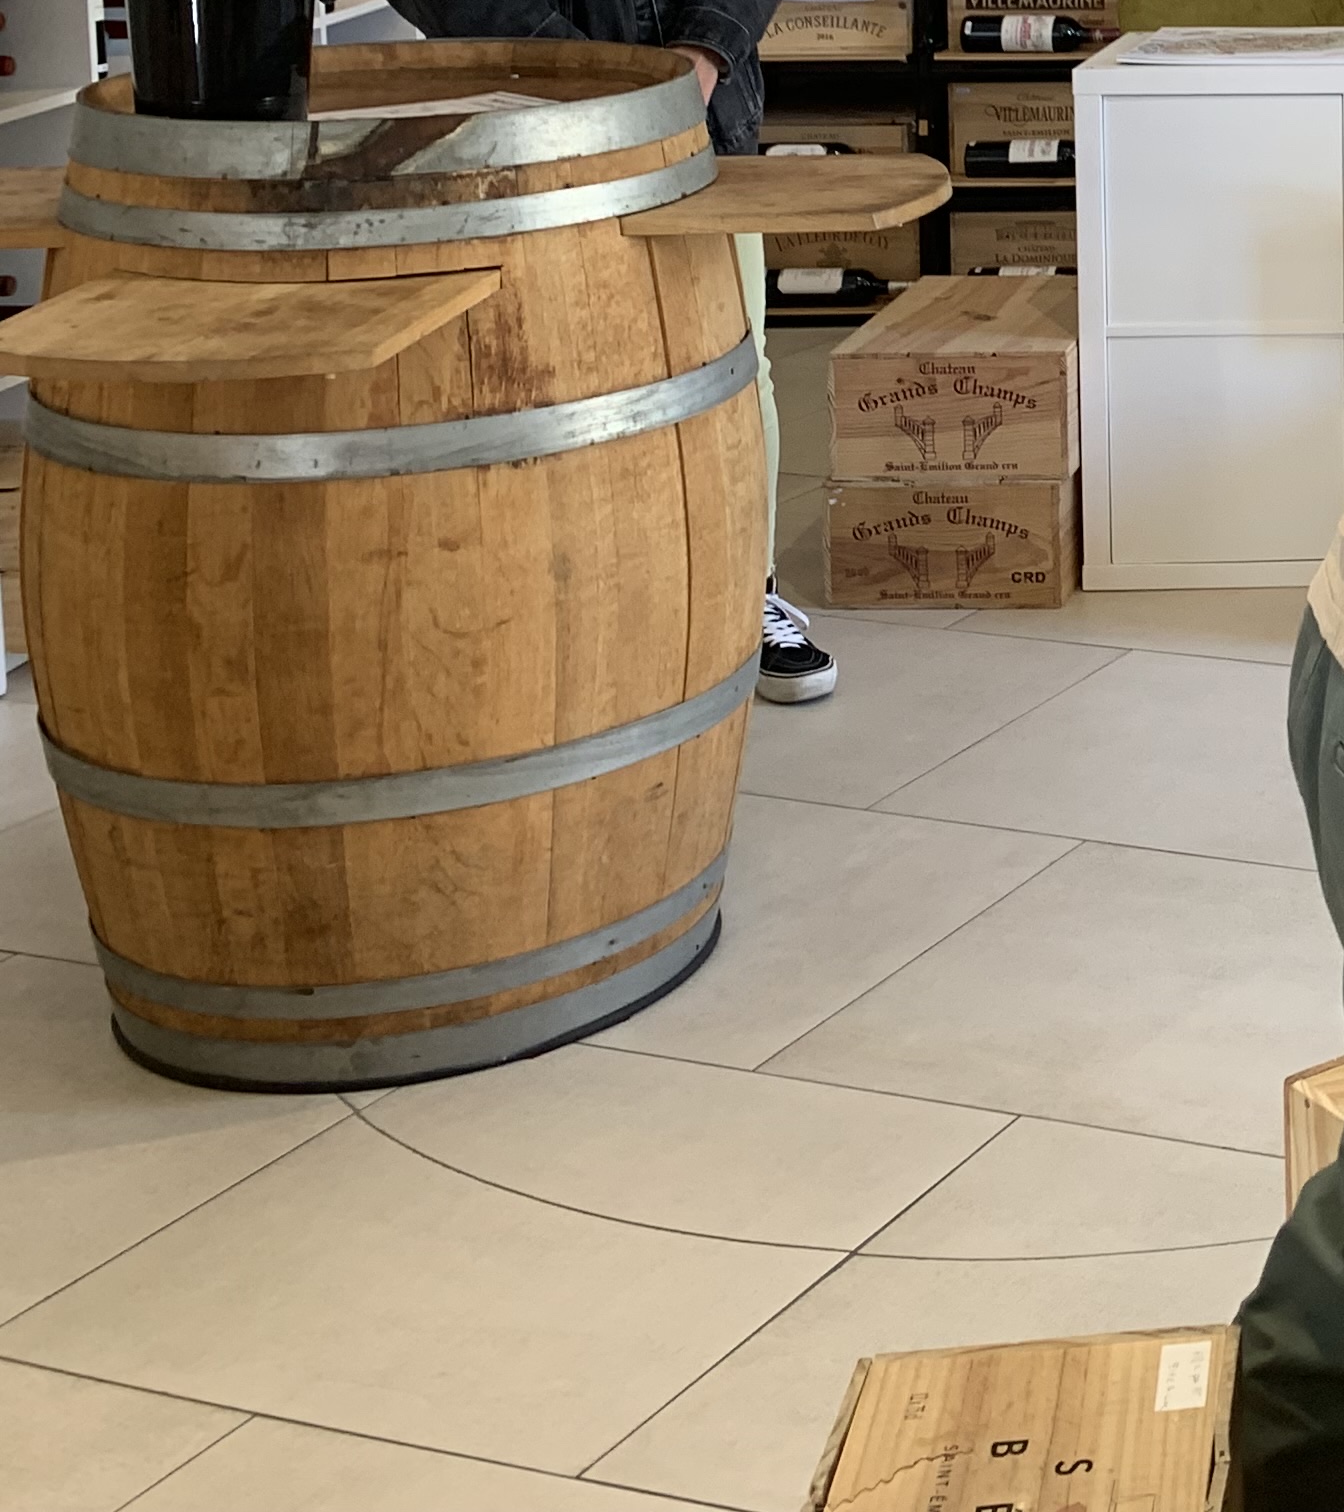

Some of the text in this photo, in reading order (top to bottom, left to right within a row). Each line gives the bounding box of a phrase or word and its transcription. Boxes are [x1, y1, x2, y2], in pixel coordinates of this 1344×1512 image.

[764, 14, 888, 39] LA CONSEILLANTE
[985, 104, 1074, 126] VILLEMAURIN
[918, 361, 976, 375] Chateau
[857, 376, 1038, 413] Grands Champs
[964, 460, 999, 472] Grand
[912, 491, 969, 505] Chateau
[851, 506, 1030, 541] Grands Champs
[1011, 571, 1046, 584] CRD
